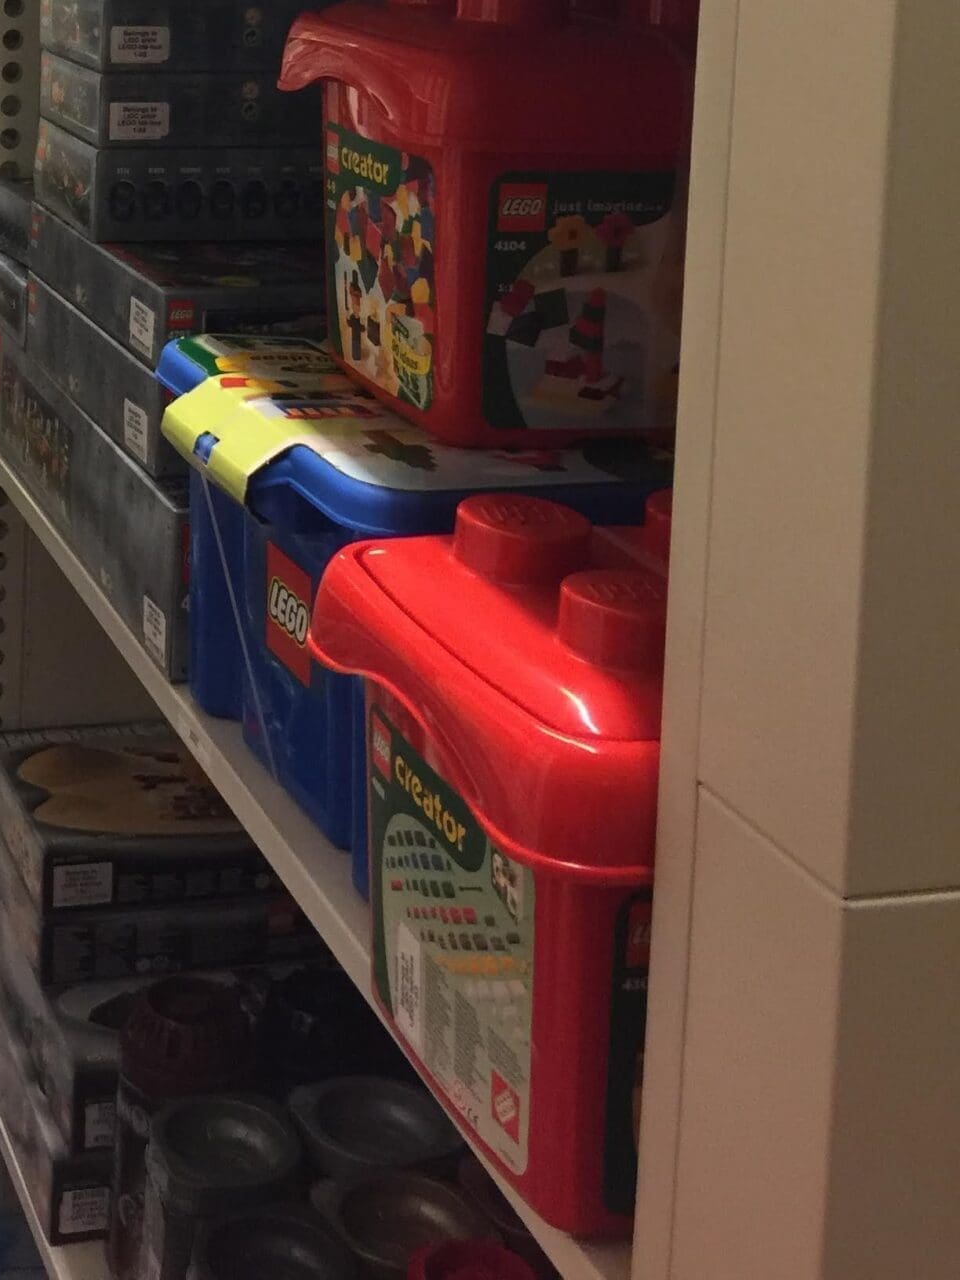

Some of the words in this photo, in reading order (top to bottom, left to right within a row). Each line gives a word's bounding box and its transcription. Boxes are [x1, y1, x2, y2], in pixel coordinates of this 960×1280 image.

[341, 147, 389, 185] creator
[502, 197, 543, 216] LEGO
[494, 240, 527, 251] 4104
[170, 309, 193, 320] LEGO
[270, 578, 309, 647] LEGO
[395, 755, 466, 852] creator
